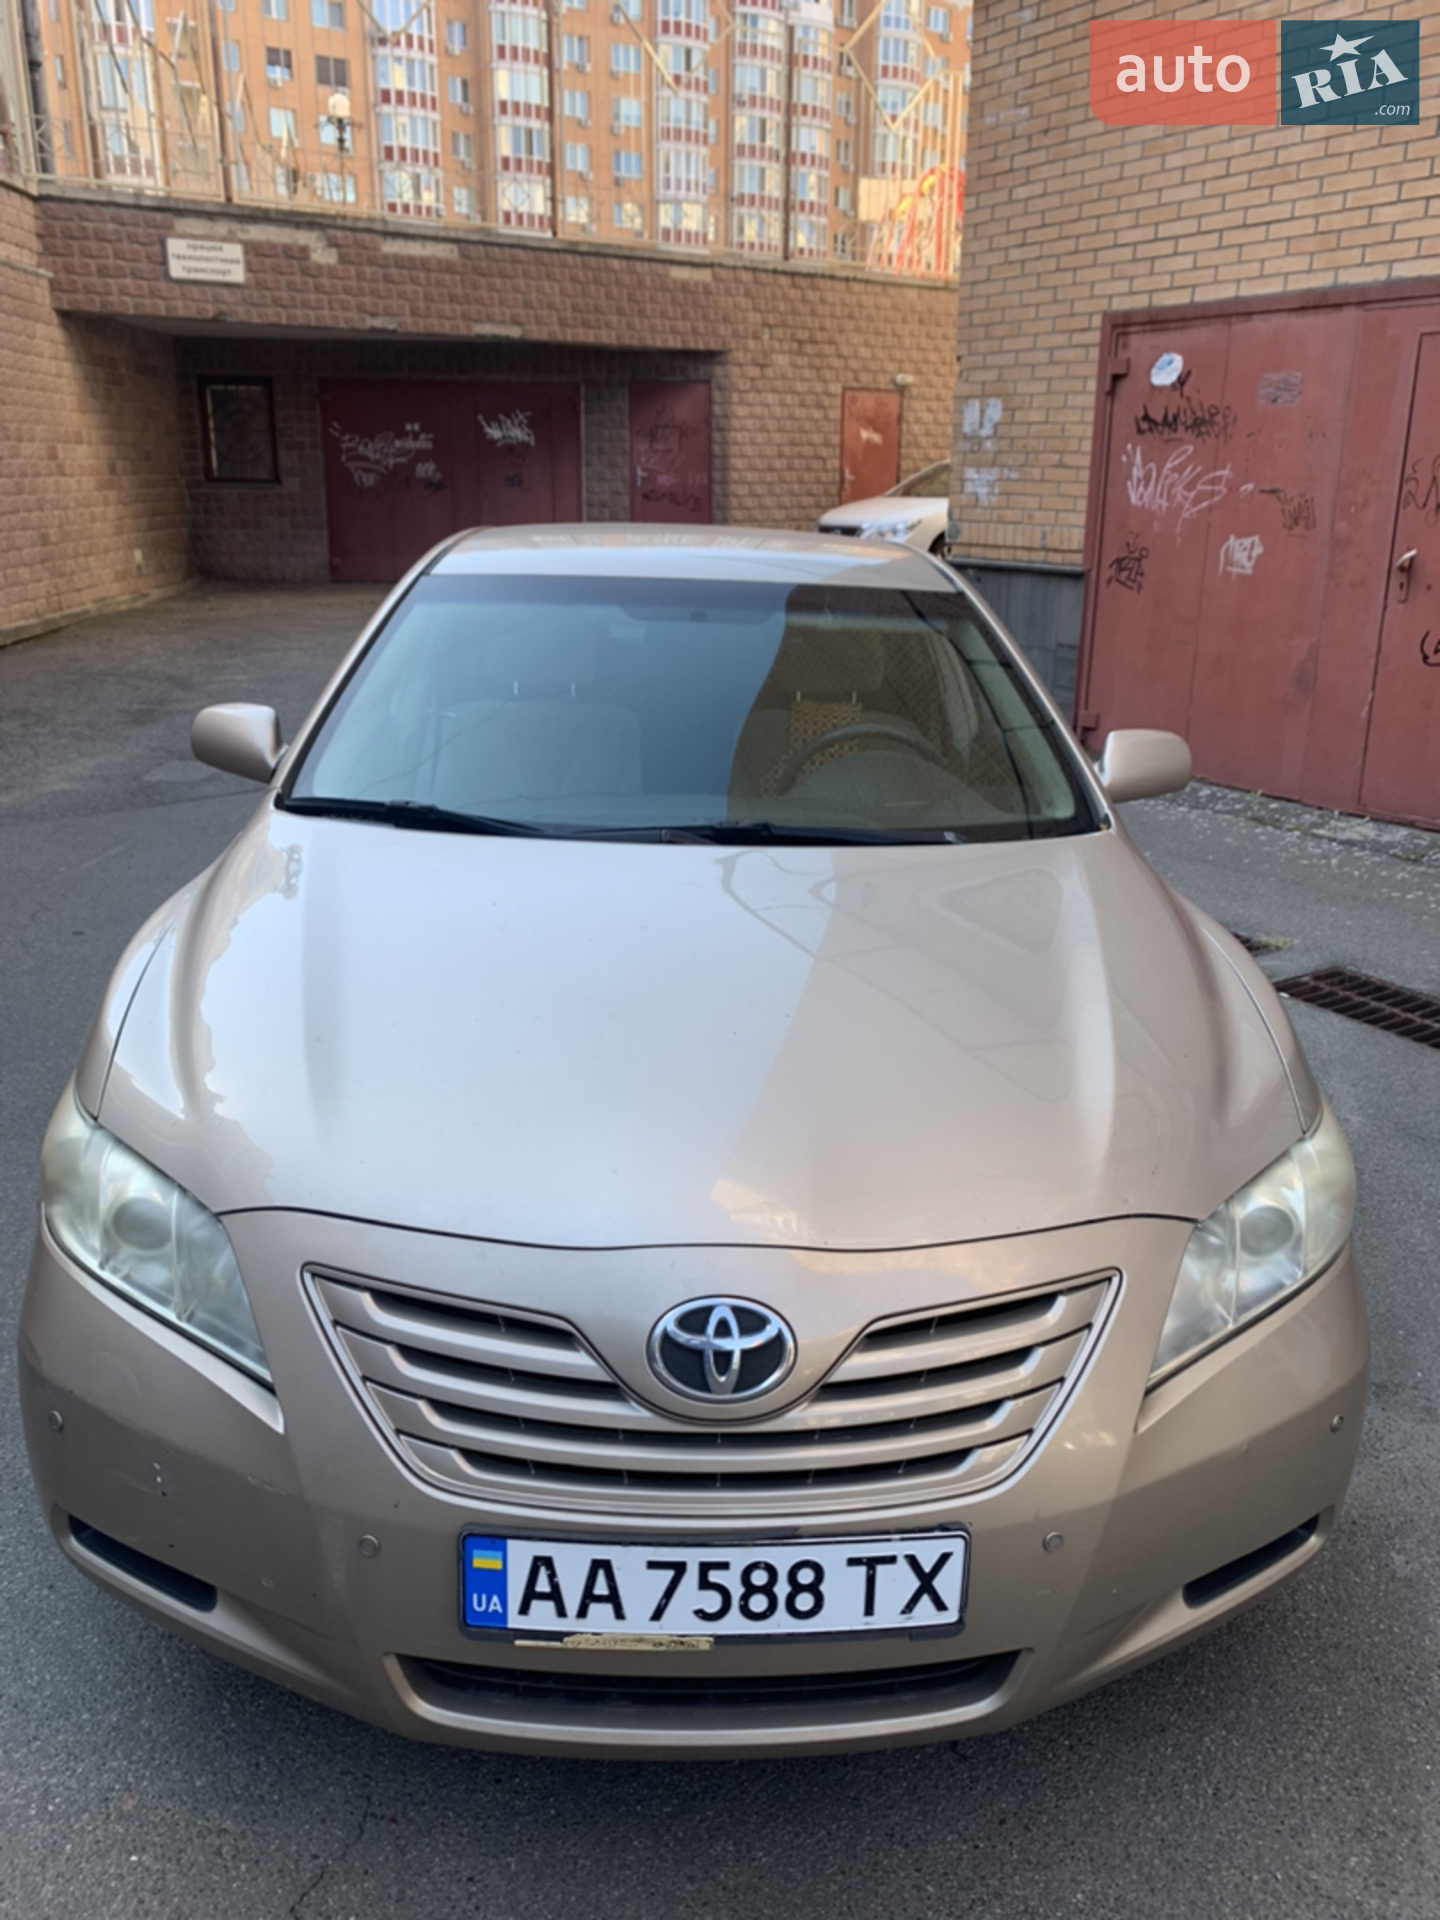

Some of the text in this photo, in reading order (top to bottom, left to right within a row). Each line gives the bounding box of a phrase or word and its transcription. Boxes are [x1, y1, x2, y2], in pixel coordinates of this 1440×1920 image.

[473, 1551, 954, 1622] UA AA 7588 TX
